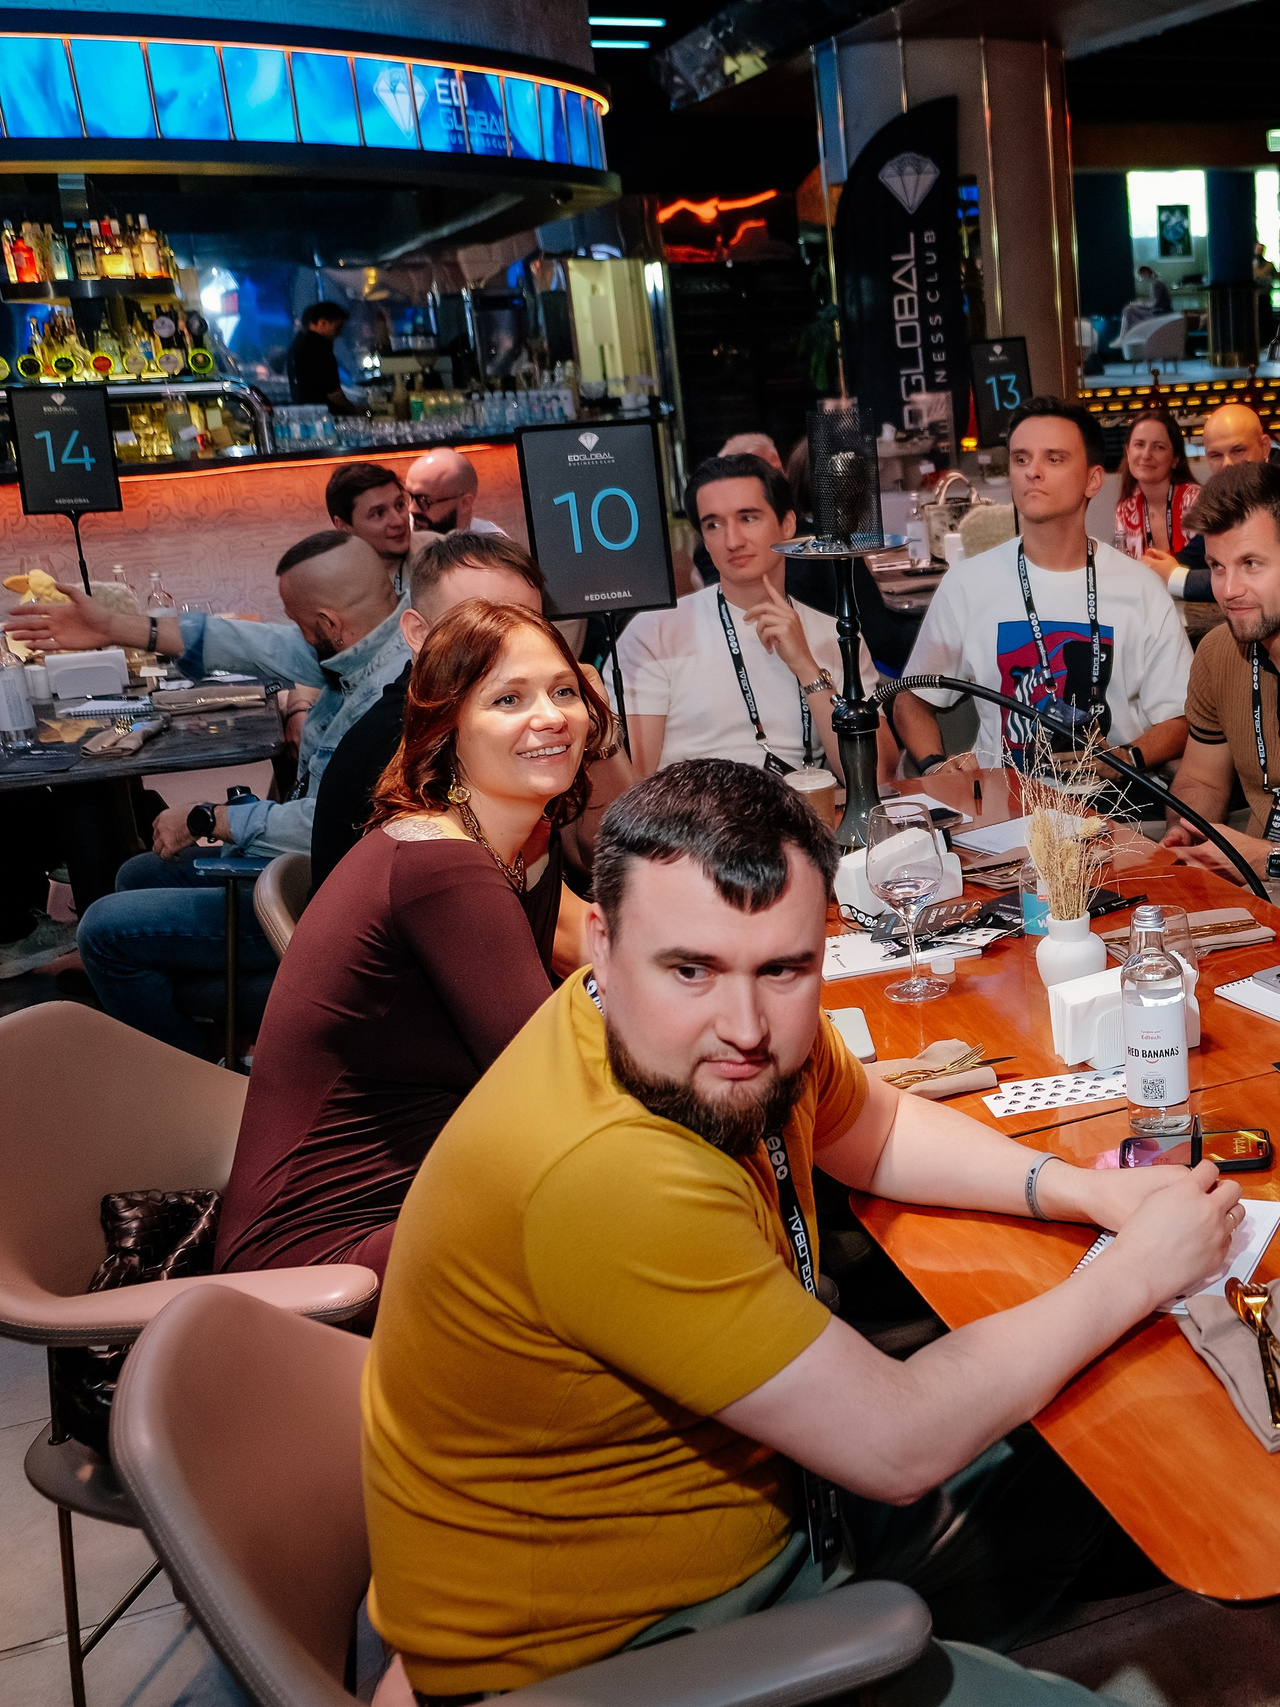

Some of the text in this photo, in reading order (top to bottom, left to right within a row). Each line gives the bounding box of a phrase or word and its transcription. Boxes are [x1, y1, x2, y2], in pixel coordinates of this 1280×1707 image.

[434, 78, 469, 107] ED
[925, 230, 940, 303] CLUB
[891, 232, 927, 429] DGLOBAL
[986, 373, 1021, 412] 13
[34, 429, 96, 473] 14
[567, 452, 615, 462] EDGLOBAL
[553, 487, 639, 554] 10
[584, 590, 632, 602] #EDGLOBAL
[1253, 705, 1266, 758] EDGLOBAL
[1127, 1045, 1180, 1059] RED BANANAS
